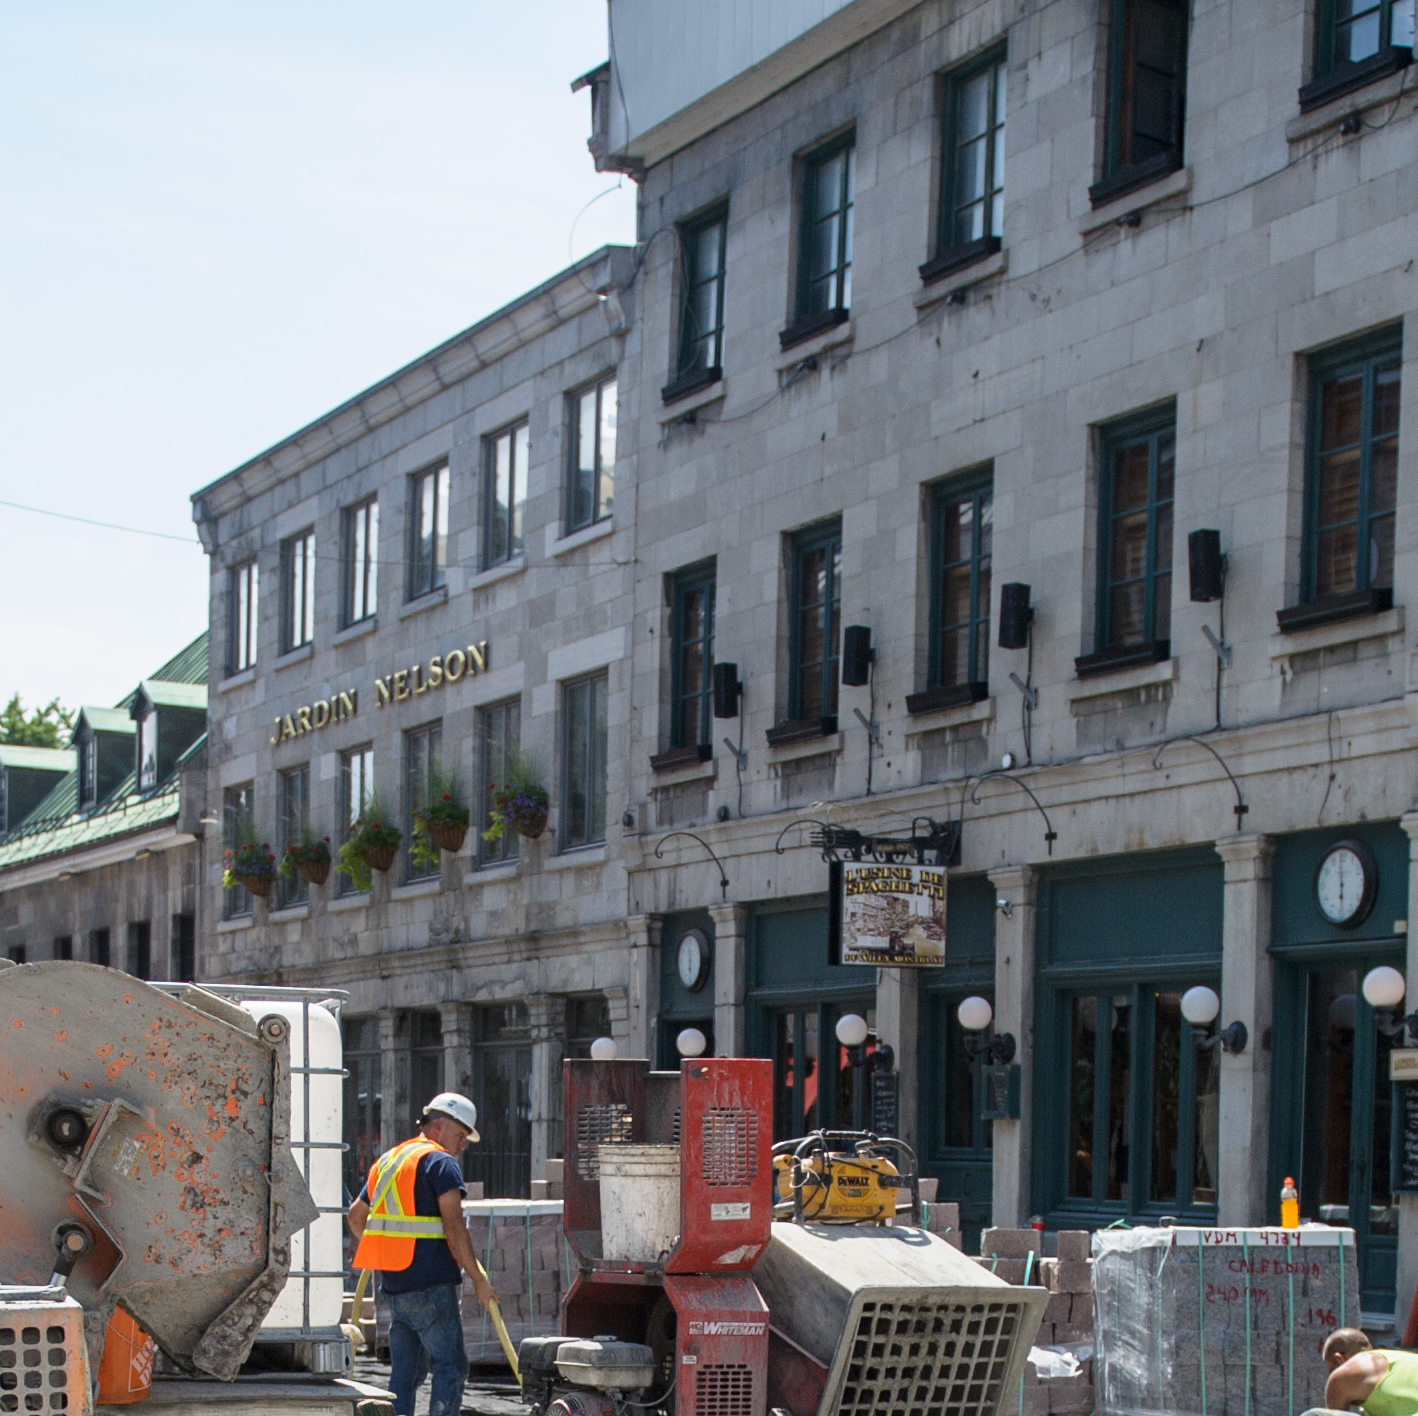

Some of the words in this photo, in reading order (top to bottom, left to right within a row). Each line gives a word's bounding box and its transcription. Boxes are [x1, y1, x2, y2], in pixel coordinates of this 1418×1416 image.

[270, 688, 357, 745] JARDIN
[375, 640, 488, 708] NELSON
[920, 870, 943, 885] DE
[846, 880, 944, 900] SPAGHETTI
[1203, 1231, 1238, 1245] VDM
